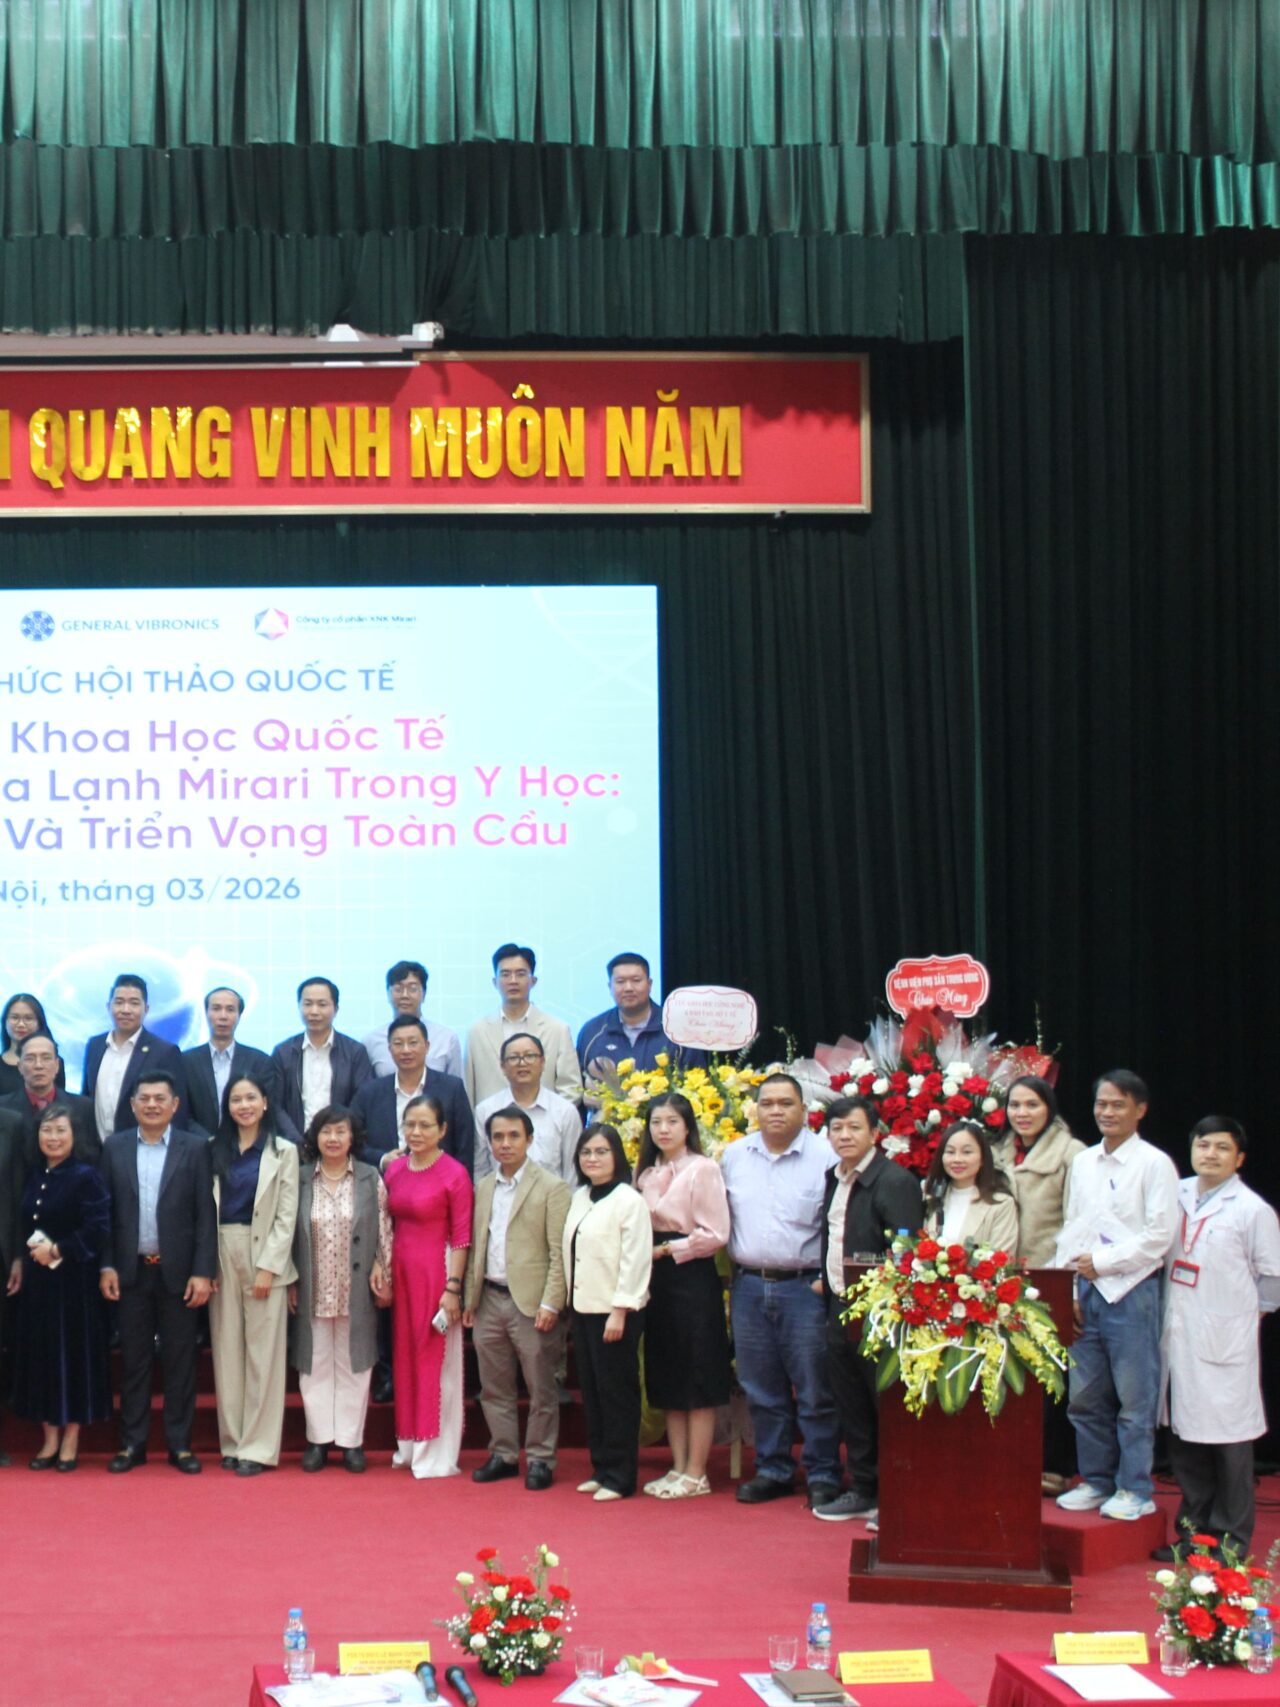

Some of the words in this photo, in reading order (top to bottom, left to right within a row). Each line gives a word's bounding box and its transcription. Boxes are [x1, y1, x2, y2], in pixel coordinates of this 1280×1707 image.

[29, 405, 233, 489] QUANG
[250, 405, 391, 479] VINH
[409, 383, 587, 480] MUÔN
[605, 389, 743, 478] NĂM
[61, 618, 132, 632] GENERAL
[135, 617, 220, 631] VIBRONICS
[75, 665, 133, 701] HỘI
[143, 662, 236, 694] THẢO
[246, 661, 348, 693] QUỐC
[358, 660, 398, 692] TẾ
[10, 720, 131, 754] Khoa
[147, 719, 238, 762] Học
[252, 714, 379, 753] Quốc
[394, 714, 447, 751] Tế
[48, 768, 160, 811] Lạnh
[178, 767, 309, 801] Mirari
[325, 766, 458, 807] Trong
[473, 765, 502, 798] Y
[520, 765, 621, 807] Học:
[4, 817, 63, 850] Và
[80, 811, 193, 850] Triển
[208, 815, 329, 859] Vọng
[344, 814, 457, 848] Toàn
[472, 808, 568, 847] Cầu
[59, 878, 155, 908] tháng
[166, 875, 301, 903] 03/2026
